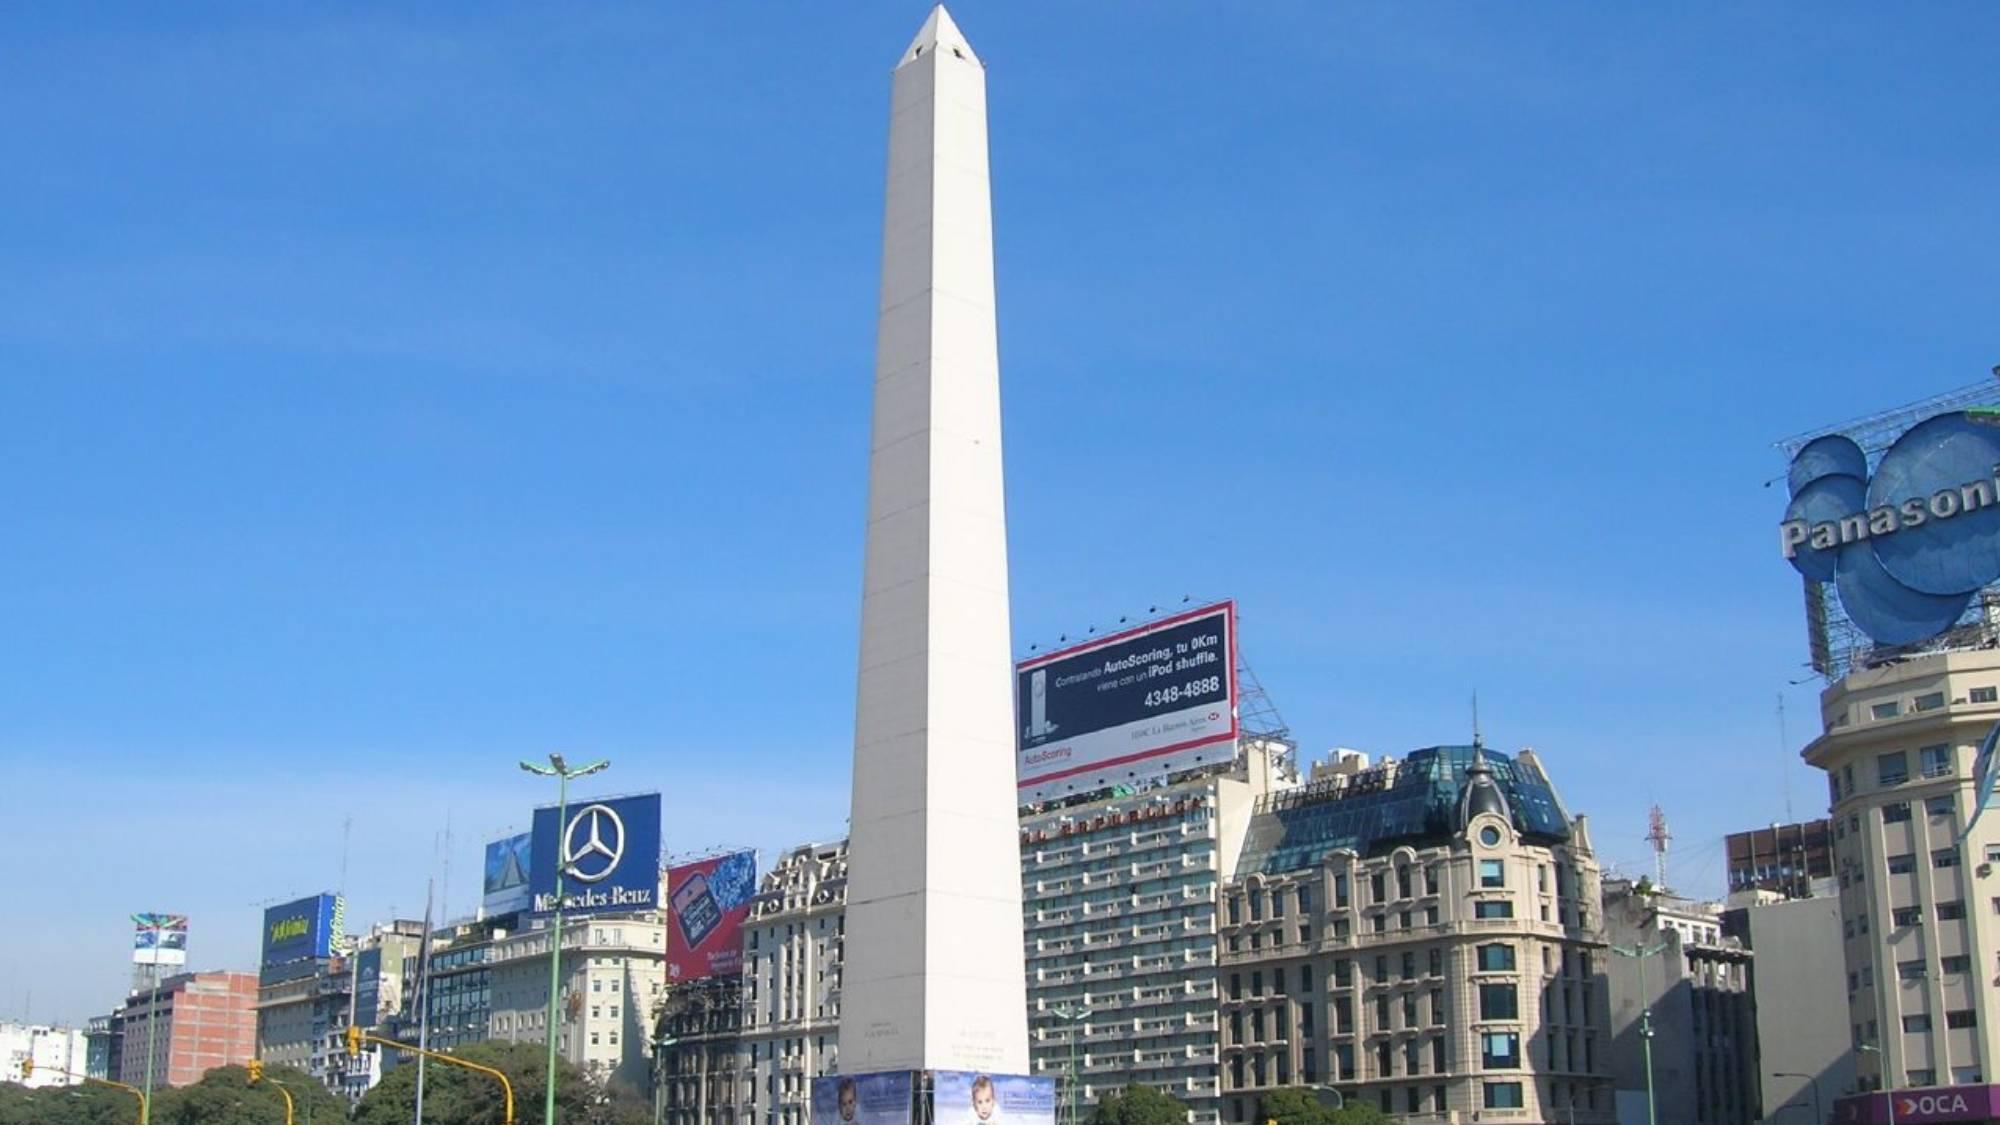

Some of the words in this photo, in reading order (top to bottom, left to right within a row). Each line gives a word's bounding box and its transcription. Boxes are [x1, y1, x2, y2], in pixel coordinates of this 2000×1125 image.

[1103, 647, 1173, 674] AutoScoring,
[1176, 642, 1188, 654] tu
[1191, 634, 1217, 650] 0Km
[1119, 675, 1135, 686] con
[1136, 672, 1147, 682] un
[1148, 660, 1173, 678] iPod
[1176, 651, 1218, 671] shuffle.
[1144, 676, 1220, 707] 4348-4888
[1024, 746, 1072, 765] AutoScoring
[1919, 1094, 1968, 1114] OCA
